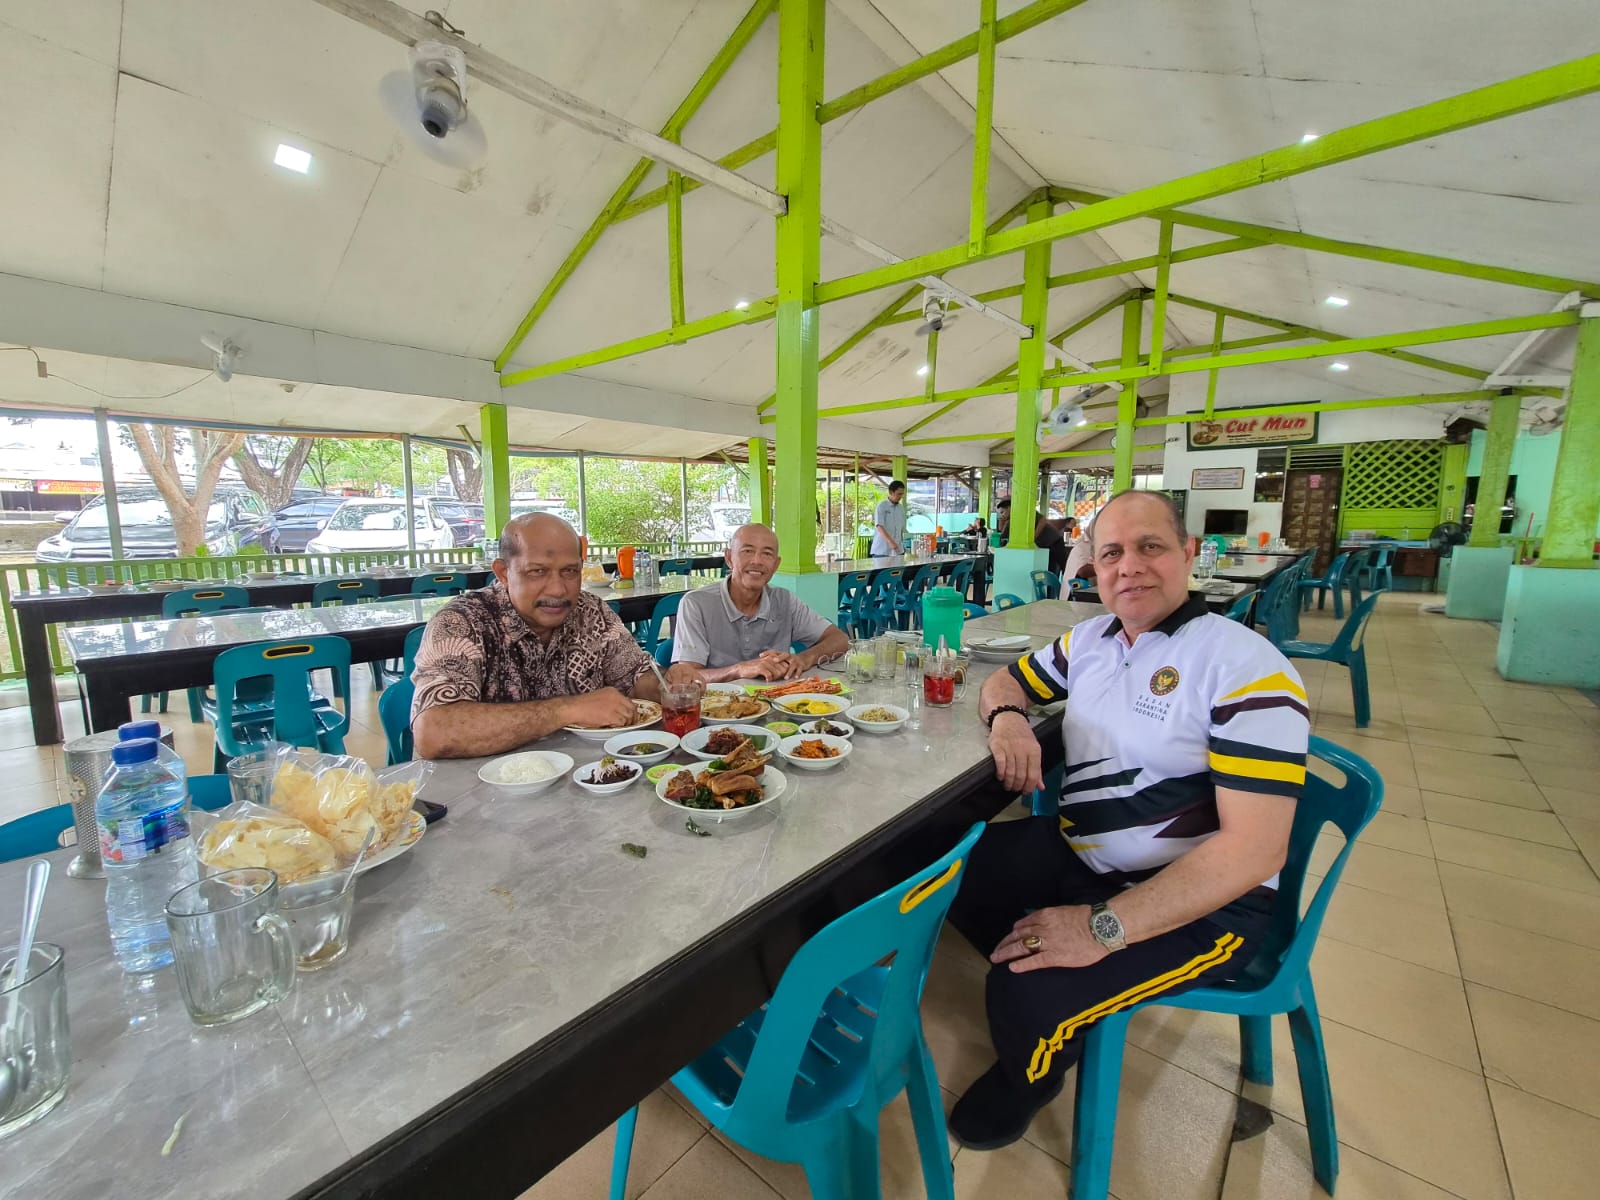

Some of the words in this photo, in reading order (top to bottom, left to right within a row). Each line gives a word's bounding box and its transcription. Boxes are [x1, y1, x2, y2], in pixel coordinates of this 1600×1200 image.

[1226, 420, 1258, 434] Cut
[1262, 416, 1308, 431] Mun
[1133, 707, 1165, 721] INDONESIA
[1136, 701, 1167, 715] KARANTINA
